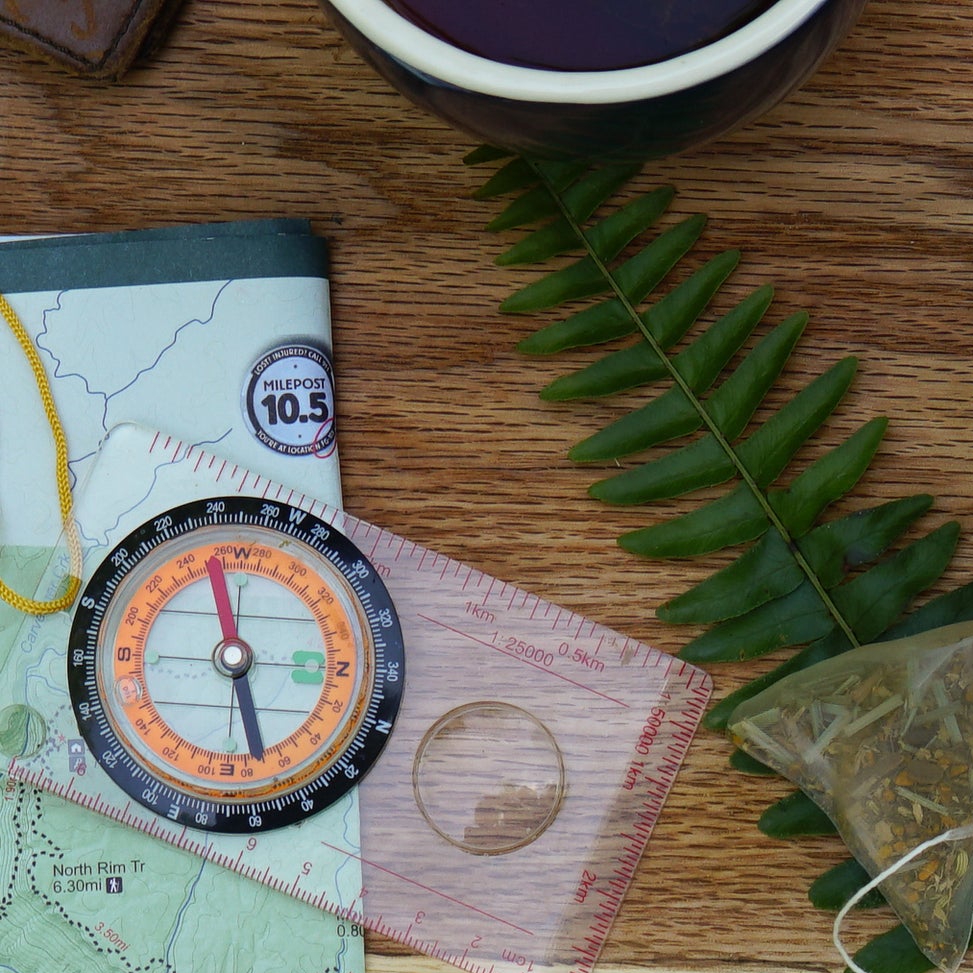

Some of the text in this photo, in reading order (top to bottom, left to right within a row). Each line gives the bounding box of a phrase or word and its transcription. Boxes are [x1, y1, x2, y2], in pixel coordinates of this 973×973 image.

[263, 378, 326, 391] MILEPOST
[261, 392, 329, 425] 10.5
[125, 606, 139, 626] 200
[145, 575, 163, 593] 220
[176, 554, 195, 569] 240
[214, 545, 233, 557] 260
[234, 547, 252, 559] W
[252, 547, 272, 559] 280
[288, 561, 307, 577] 300
[336, 661, 350, 677] N
[463, 600, 497, 624] 1km
[73, 501, 399, 825] 200 220 240 260 W 280 300 320 340 N 20 40 80 E 100 120 140 160 S
[558, 641, 606, 673] 0.5km
[53, 860, 146, 877] North Rim Tr
[53, 880, 102, 893] 6.30mi
[574, 869, 598, 904] 2km
[94, 922, 131, 951] 3.50mi
